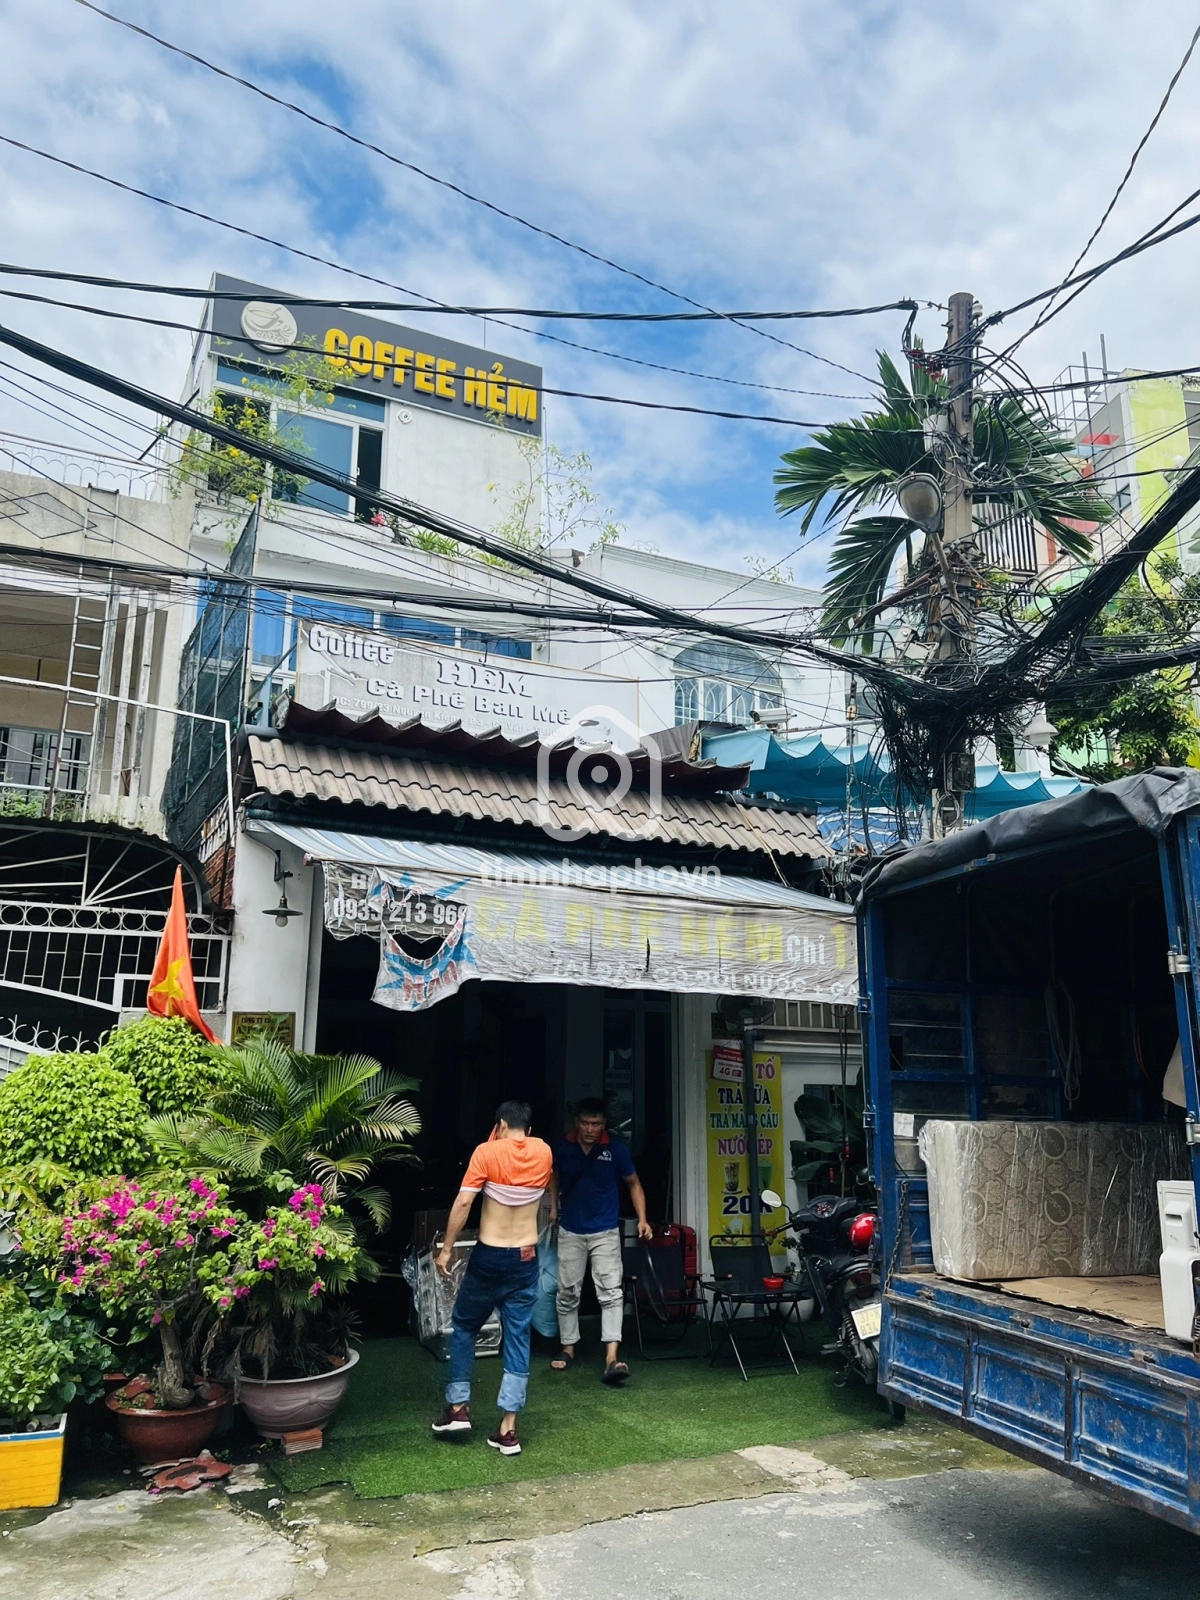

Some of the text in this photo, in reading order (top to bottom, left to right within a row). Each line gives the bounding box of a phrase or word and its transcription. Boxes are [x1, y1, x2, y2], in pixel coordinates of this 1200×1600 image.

[323, 328, 538, 423] COFFEE HẺM
[412, 684, 466, 709] Phê
[389, 902, 428, 924] 213
[786, 934, 826, 965] Chỉ
[719, 1067, 731, 1076] 4G
[755, 1055, 776, 1080] TỐ
[717, 1082, 771, 1105] TRÀ ỮA
[710, 1107, 730, 1128] TRÀ
[760, 1105, 779, 1128] CẦU
[757, 1132, 773, 1155] ÉP
